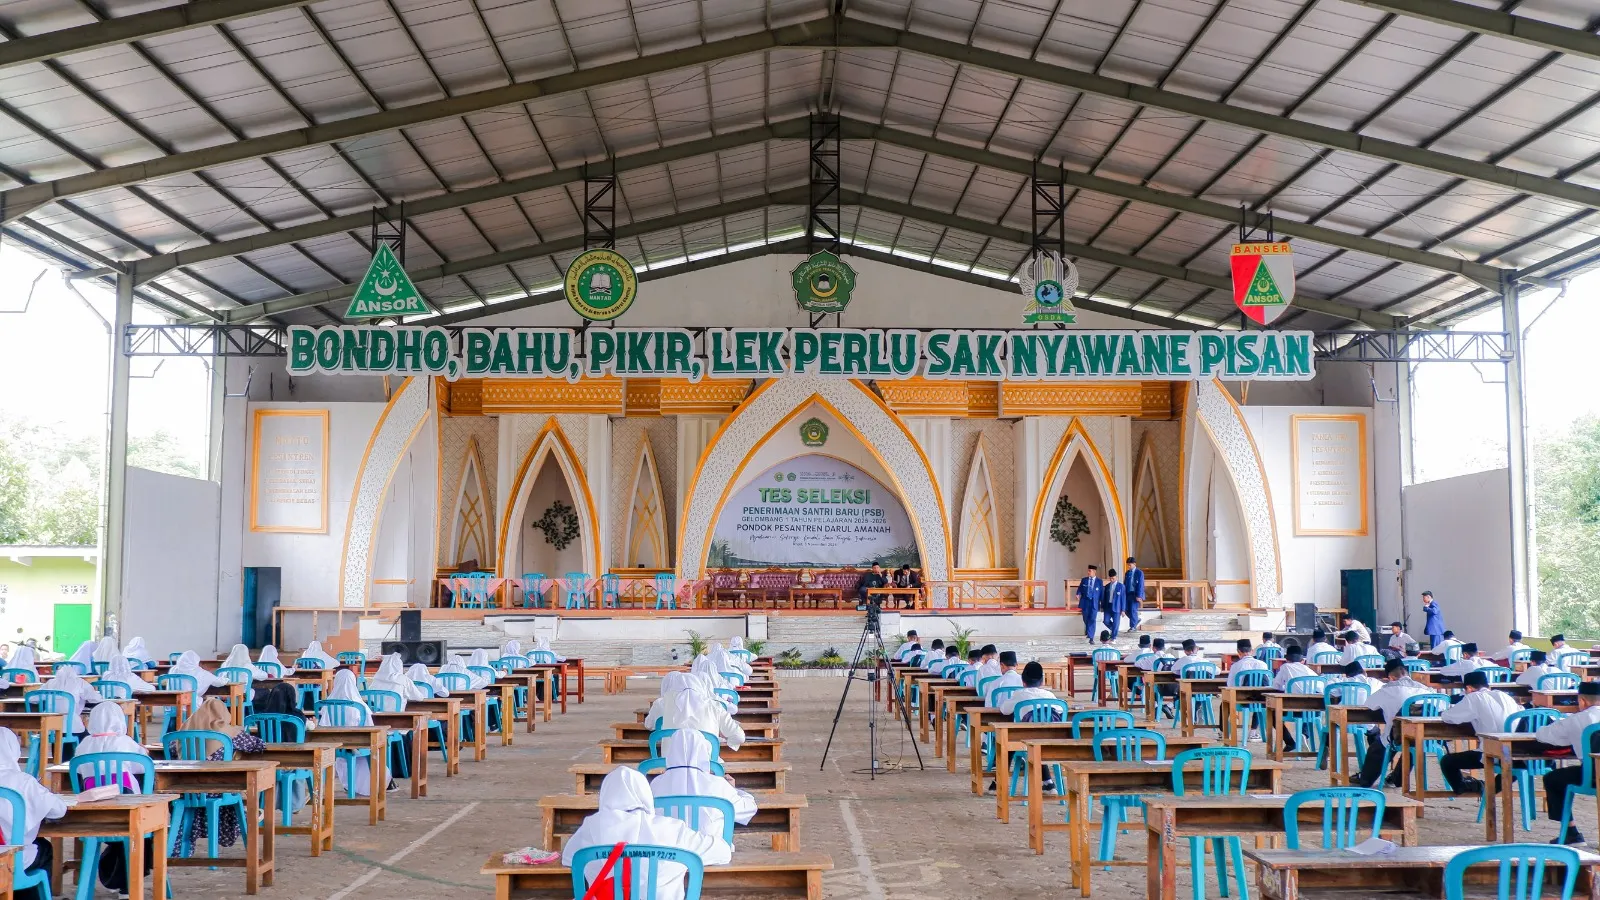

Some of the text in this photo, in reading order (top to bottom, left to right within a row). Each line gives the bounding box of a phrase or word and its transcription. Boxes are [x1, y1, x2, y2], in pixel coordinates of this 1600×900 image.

[1234, 245, 1288, 254] BANSER
[355, 296, 419, 313] ANSOR
[1248, 294, 1280, 303] ANSOR
[290, 329, 1311, 380] BONDHO, BAHU, PIKIR, LEK PERLU SAK NYAWANE PISAN
[759, 488, 870, 504] TES SELEKSI
[743, 506, 885, 518] PENERIMAAN SANTRI BARU (PSB)
[736, 524, 773, 532] PONDOK
[774, 524, 823, 532] PESANTREN
[824, 525, 852, 533] DARUL
